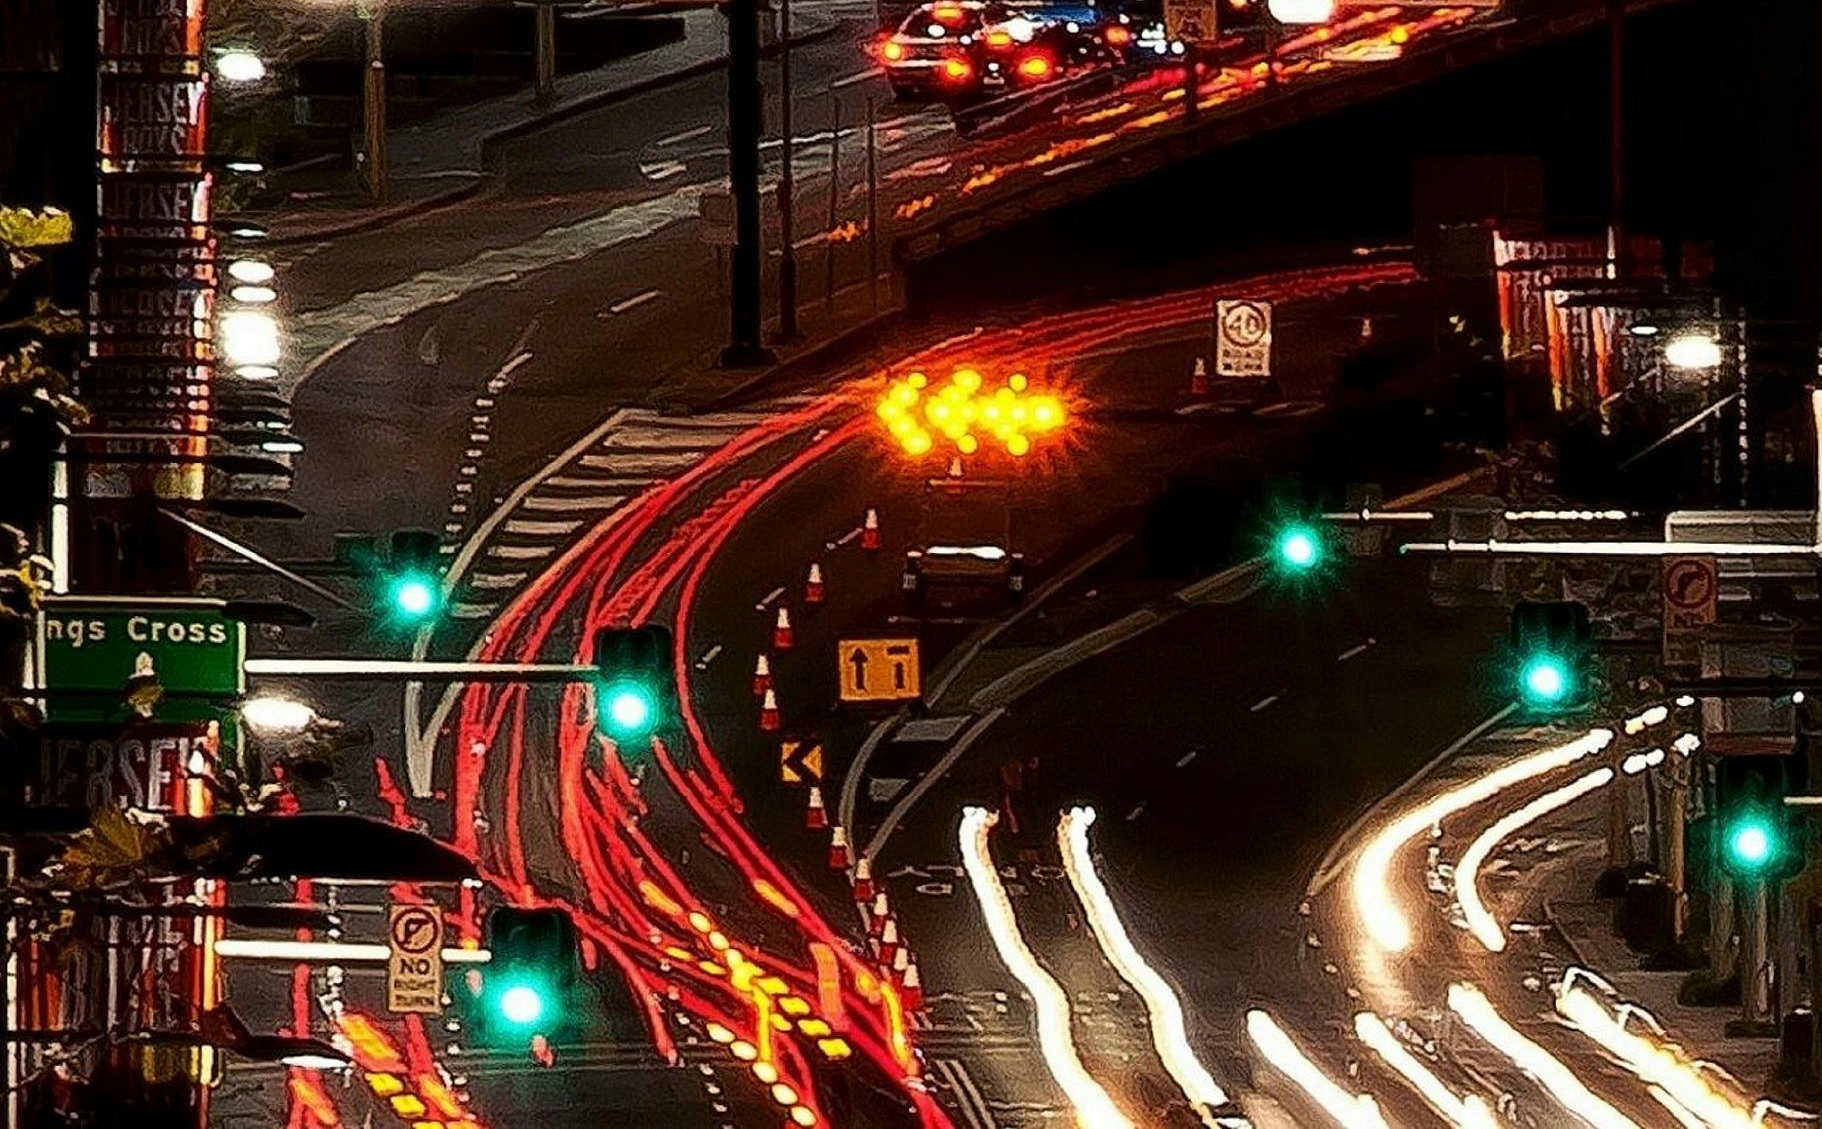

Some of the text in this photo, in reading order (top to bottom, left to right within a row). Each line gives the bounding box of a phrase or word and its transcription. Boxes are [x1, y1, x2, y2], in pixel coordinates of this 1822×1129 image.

[1228, 314, 1261, 336] 40
[127, 616, 227, 644] Cross
[399, 958, 431, 976] NO
